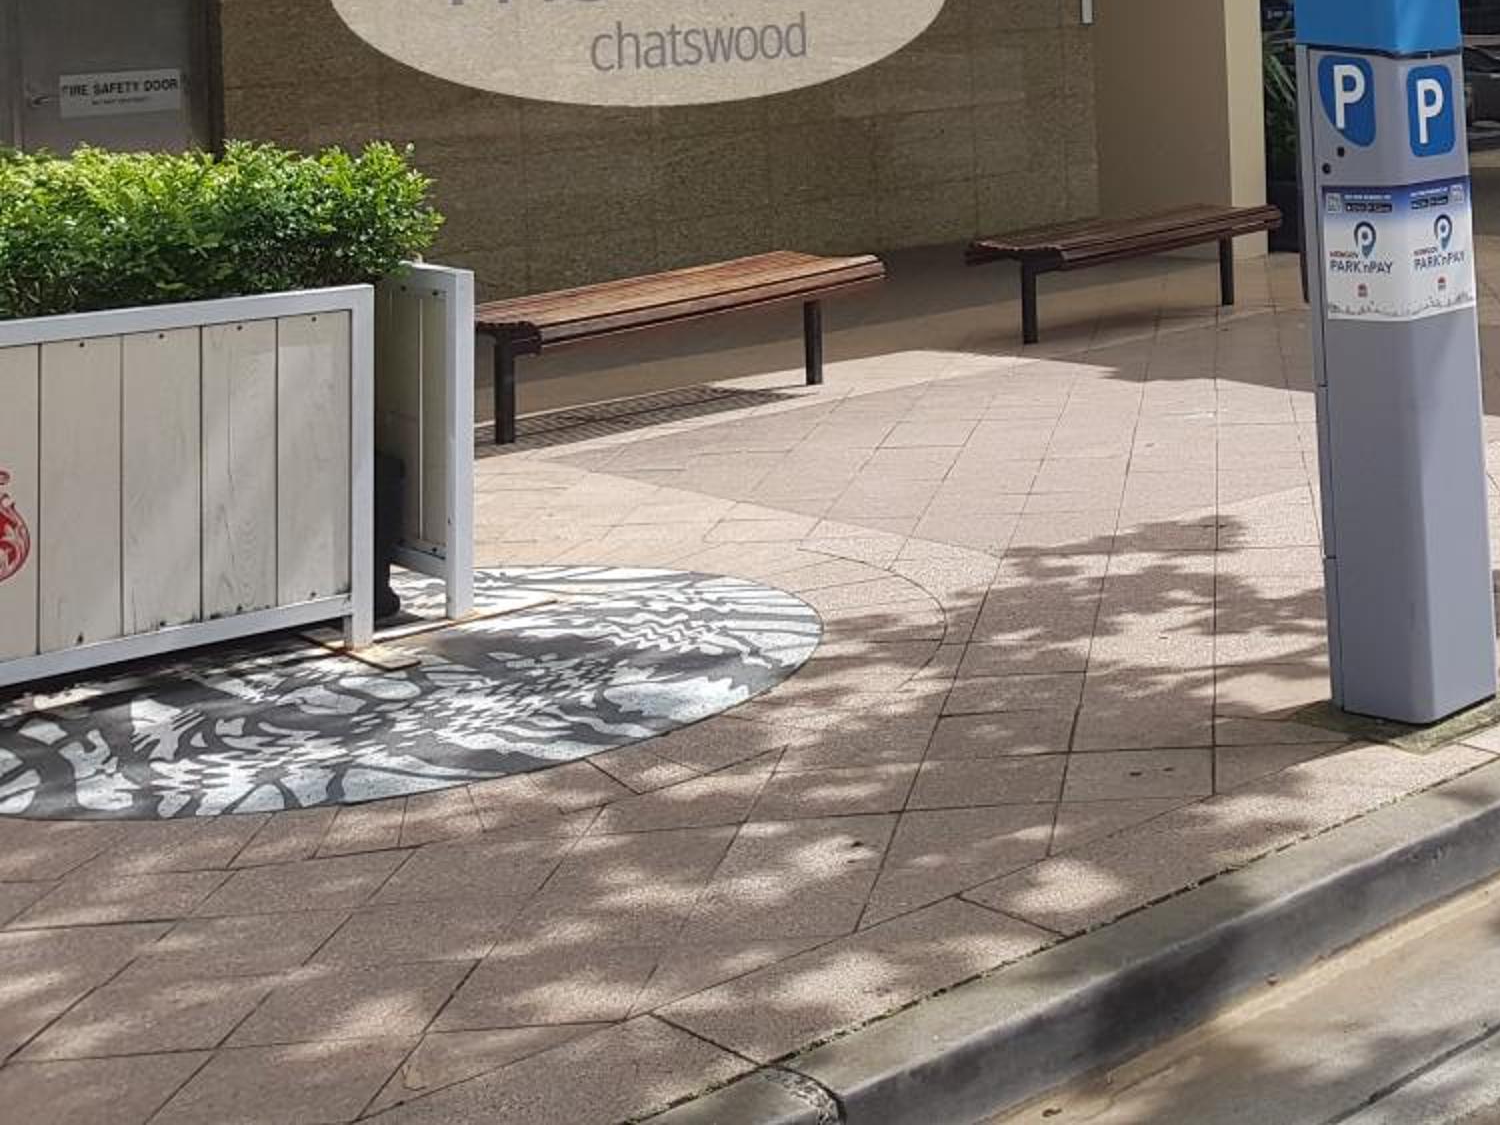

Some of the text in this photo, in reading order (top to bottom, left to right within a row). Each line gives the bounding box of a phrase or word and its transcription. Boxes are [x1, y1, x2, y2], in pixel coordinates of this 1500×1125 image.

[590, 11, 808, 71] chatswood
[62, 78, 178, 96] FIRE SAFETY DOOR
[1333, 64, 1365, 130] P
[1416, 78, 1443, 144] P
